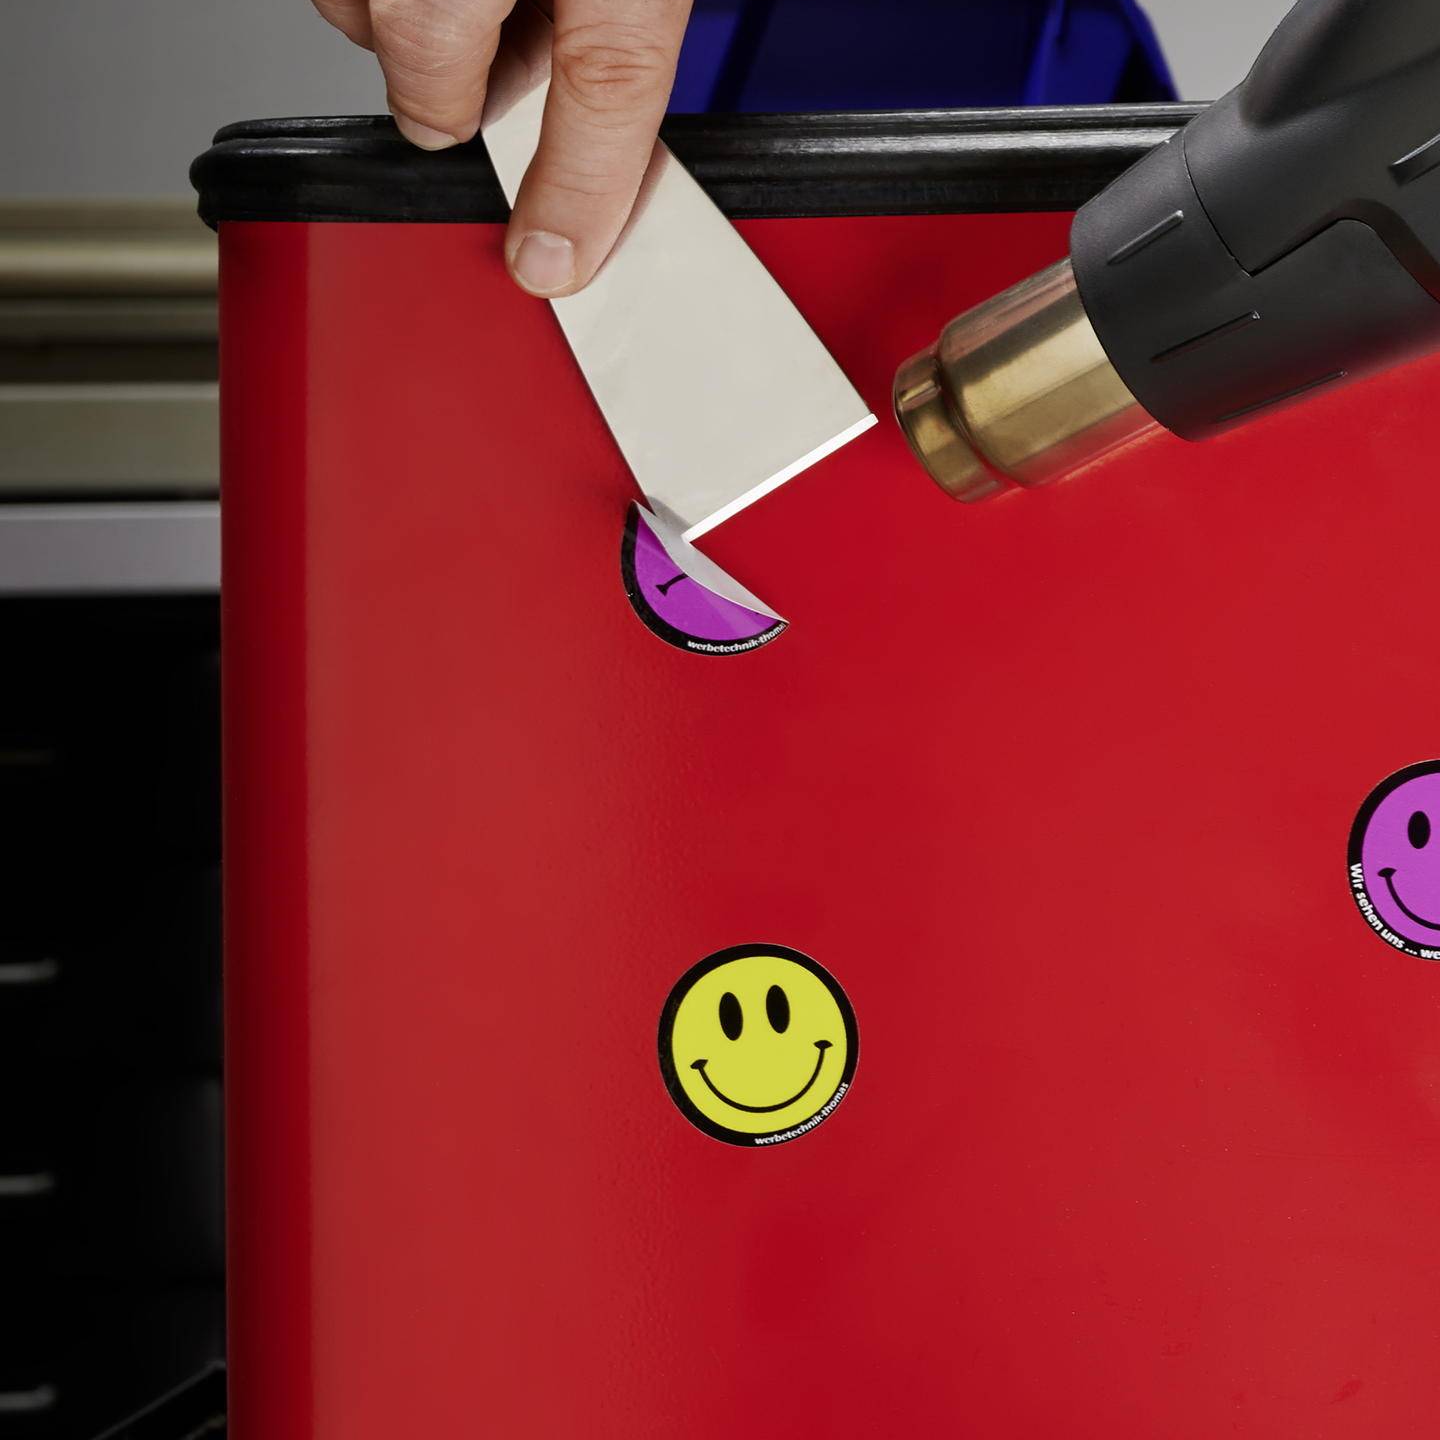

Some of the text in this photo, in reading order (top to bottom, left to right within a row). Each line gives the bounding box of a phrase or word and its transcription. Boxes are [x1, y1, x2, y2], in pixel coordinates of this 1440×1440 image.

[1350, 863, 1364, 889] Wir
[1356, 892, 1383, 931] sehen
[1381, 929, 1405, 948] uns
[755, 1082, 848, 1145] werbetechnik-thomas
